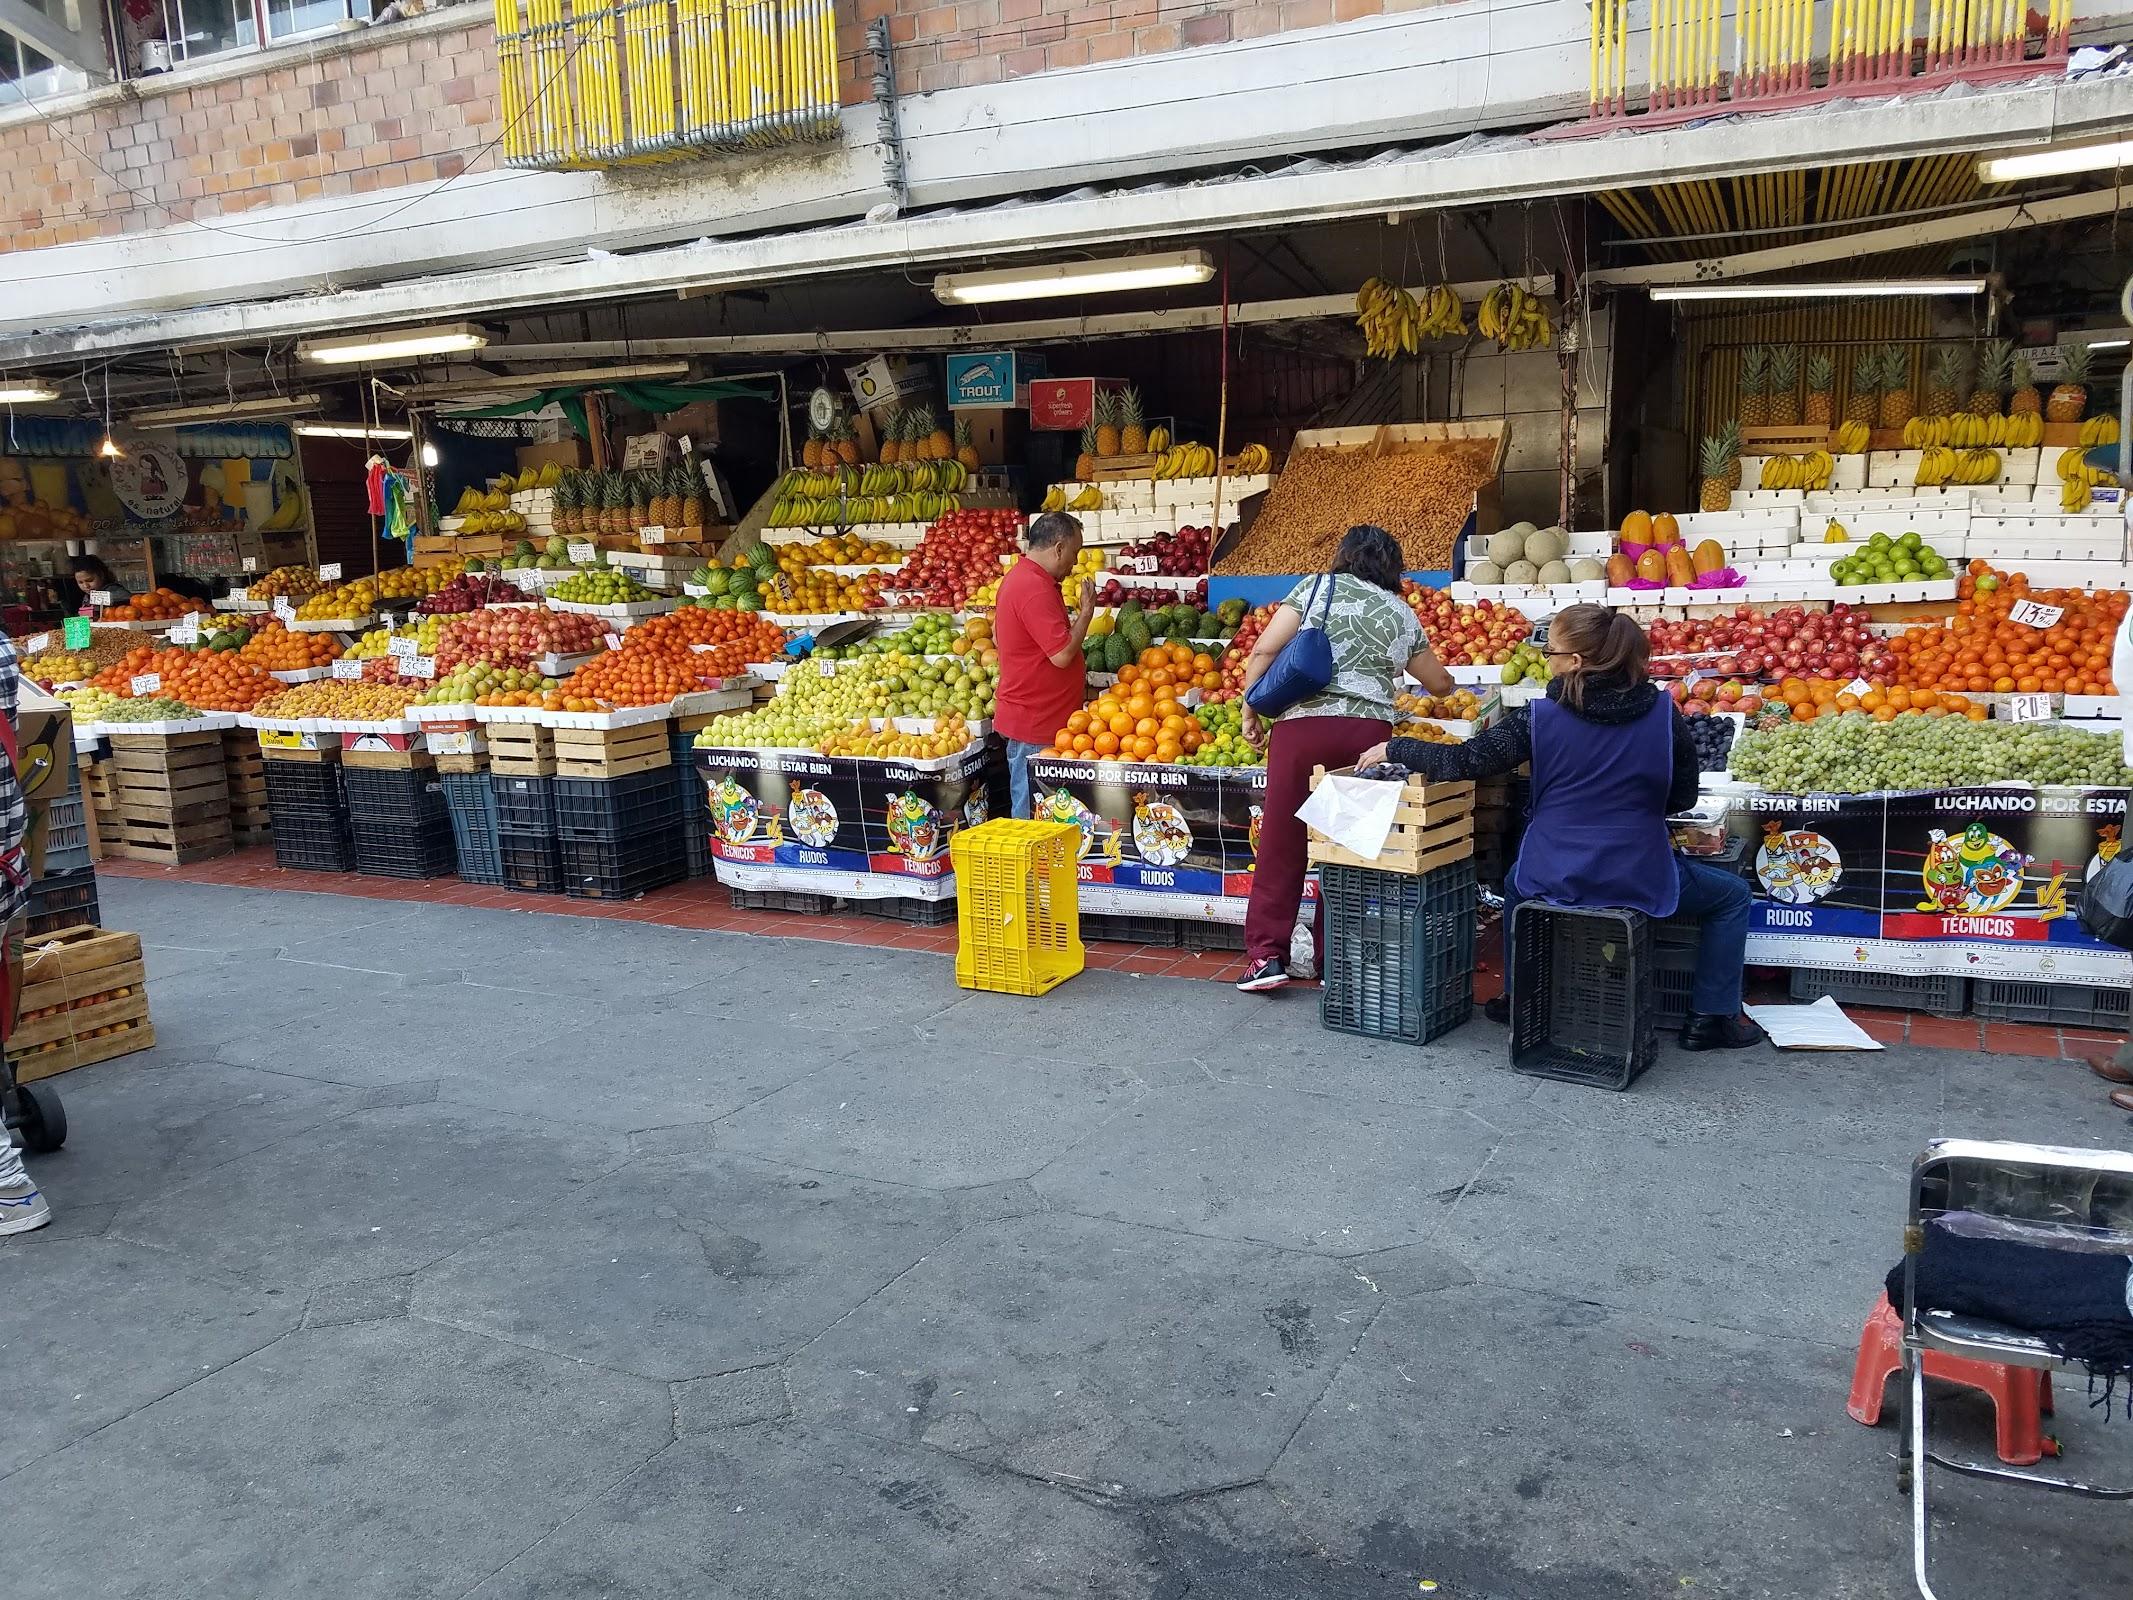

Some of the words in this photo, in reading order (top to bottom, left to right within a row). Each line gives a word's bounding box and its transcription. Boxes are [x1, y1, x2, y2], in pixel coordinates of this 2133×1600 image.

[958, 385, 1002, 399] TROUT
[708, 755, 758, 769] LUCHANDO
[760, 759, 780, 771] POR
[781, 761, 808, 774] ESTAR
[809, 762, 832, 775] BIEN
[944, 768, 964, 783] POR
[963, 758, 983, 777] ESTAR
[1034, 765, 1096, 781] LUCHANDO
[1098, 769, 1121, 783] POR
[1124, 771, 1159, 785] ESTAR
[1161, 772, 1188, 786] BIEN
[1728, 797, 1745, 811] OR
[1750, 797, 1799, 812] ESTAR
[1801, 798, 1840, 812] BIEN
[1934, 796, 2036, 812] LUCHANDO
[2041, 798, 2079, 812] POR
[2085, 798, 2128, 813] ESTA
[720, 843, 756, 861] TÉCNICOS
[799, 850, 829, 865] RUDOS
[902, 857, 942, 876] TÉCNICOS
[1140, 869, 1175, 887] RUDOS
[2036, 871, 2068, 923] VS
[1766, 908, 1813, 928] RUDOS
[1941, 914, 2016, 938] TÉCNICOS
